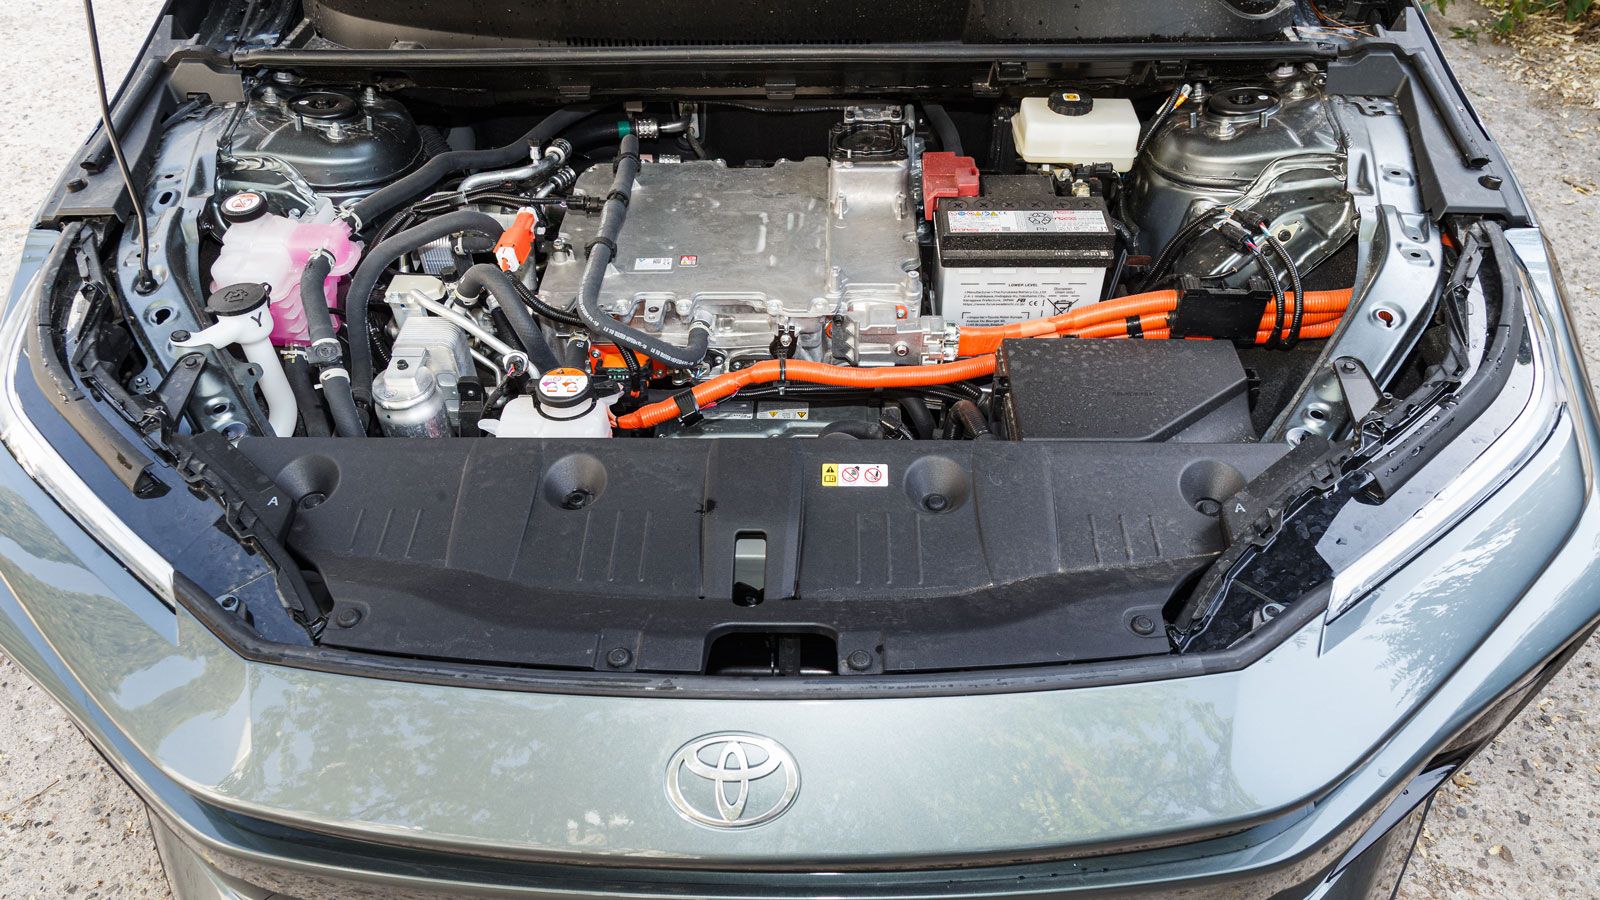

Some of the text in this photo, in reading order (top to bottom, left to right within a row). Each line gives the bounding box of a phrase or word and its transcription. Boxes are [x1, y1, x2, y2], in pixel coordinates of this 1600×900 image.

[250, 311, 262, 327] Y
[266, 496, 278, 505] A
[1235, 503, 1246, 512] A
